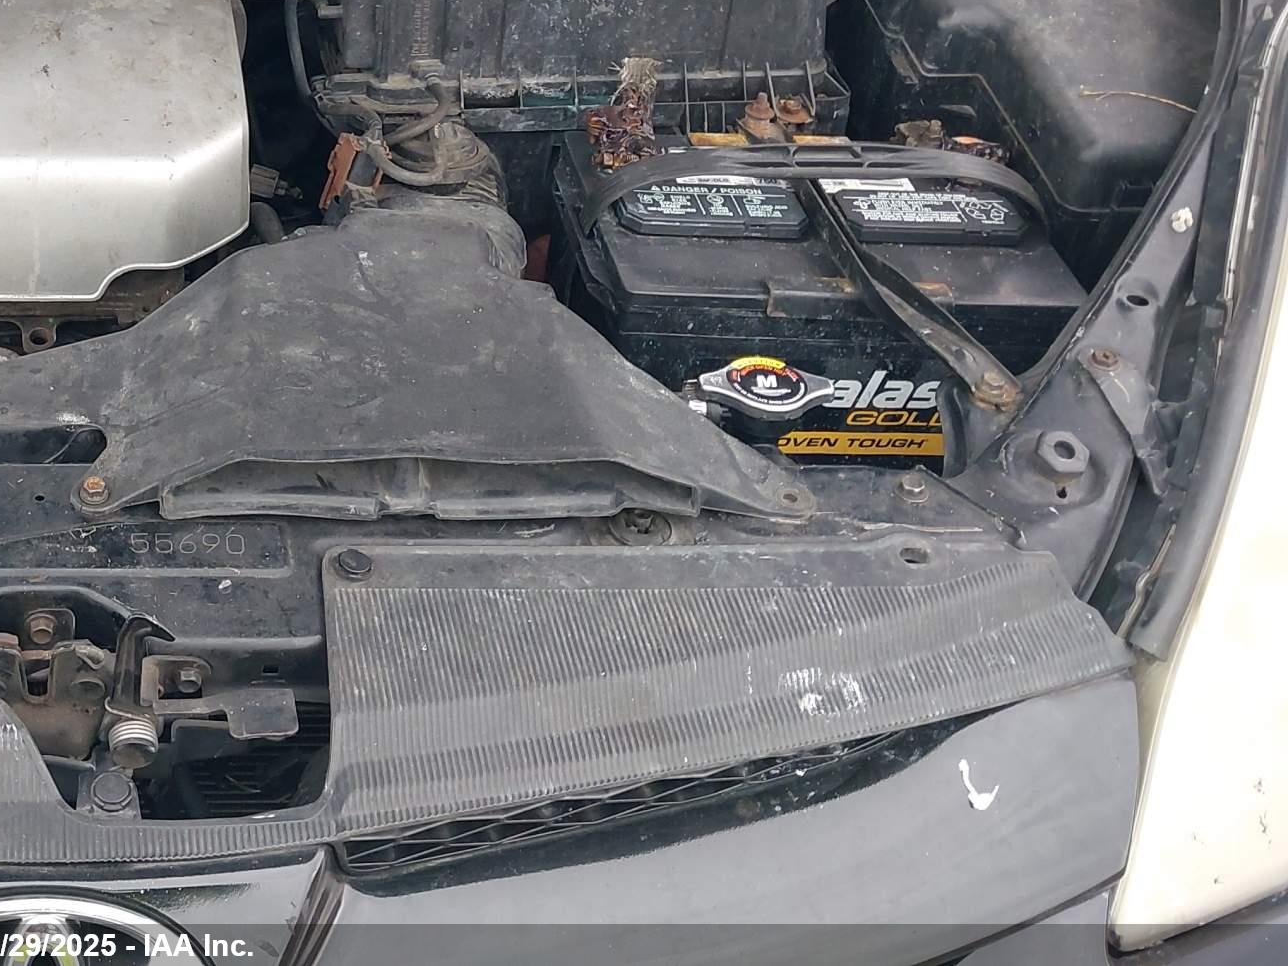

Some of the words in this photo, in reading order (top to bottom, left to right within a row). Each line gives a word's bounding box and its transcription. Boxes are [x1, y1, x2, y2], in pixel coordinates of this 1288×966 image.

[662, 185, 710, 194] DANGER
[719, 187, 763, 195] POISON
[756, 374, 778, 388] M
[822, 370, 941, 409] alas
[776, 437, 839, 448] OVEN
[847, 438, 926, 449] TOUGH
[129, 532, 245, 555] 55690
